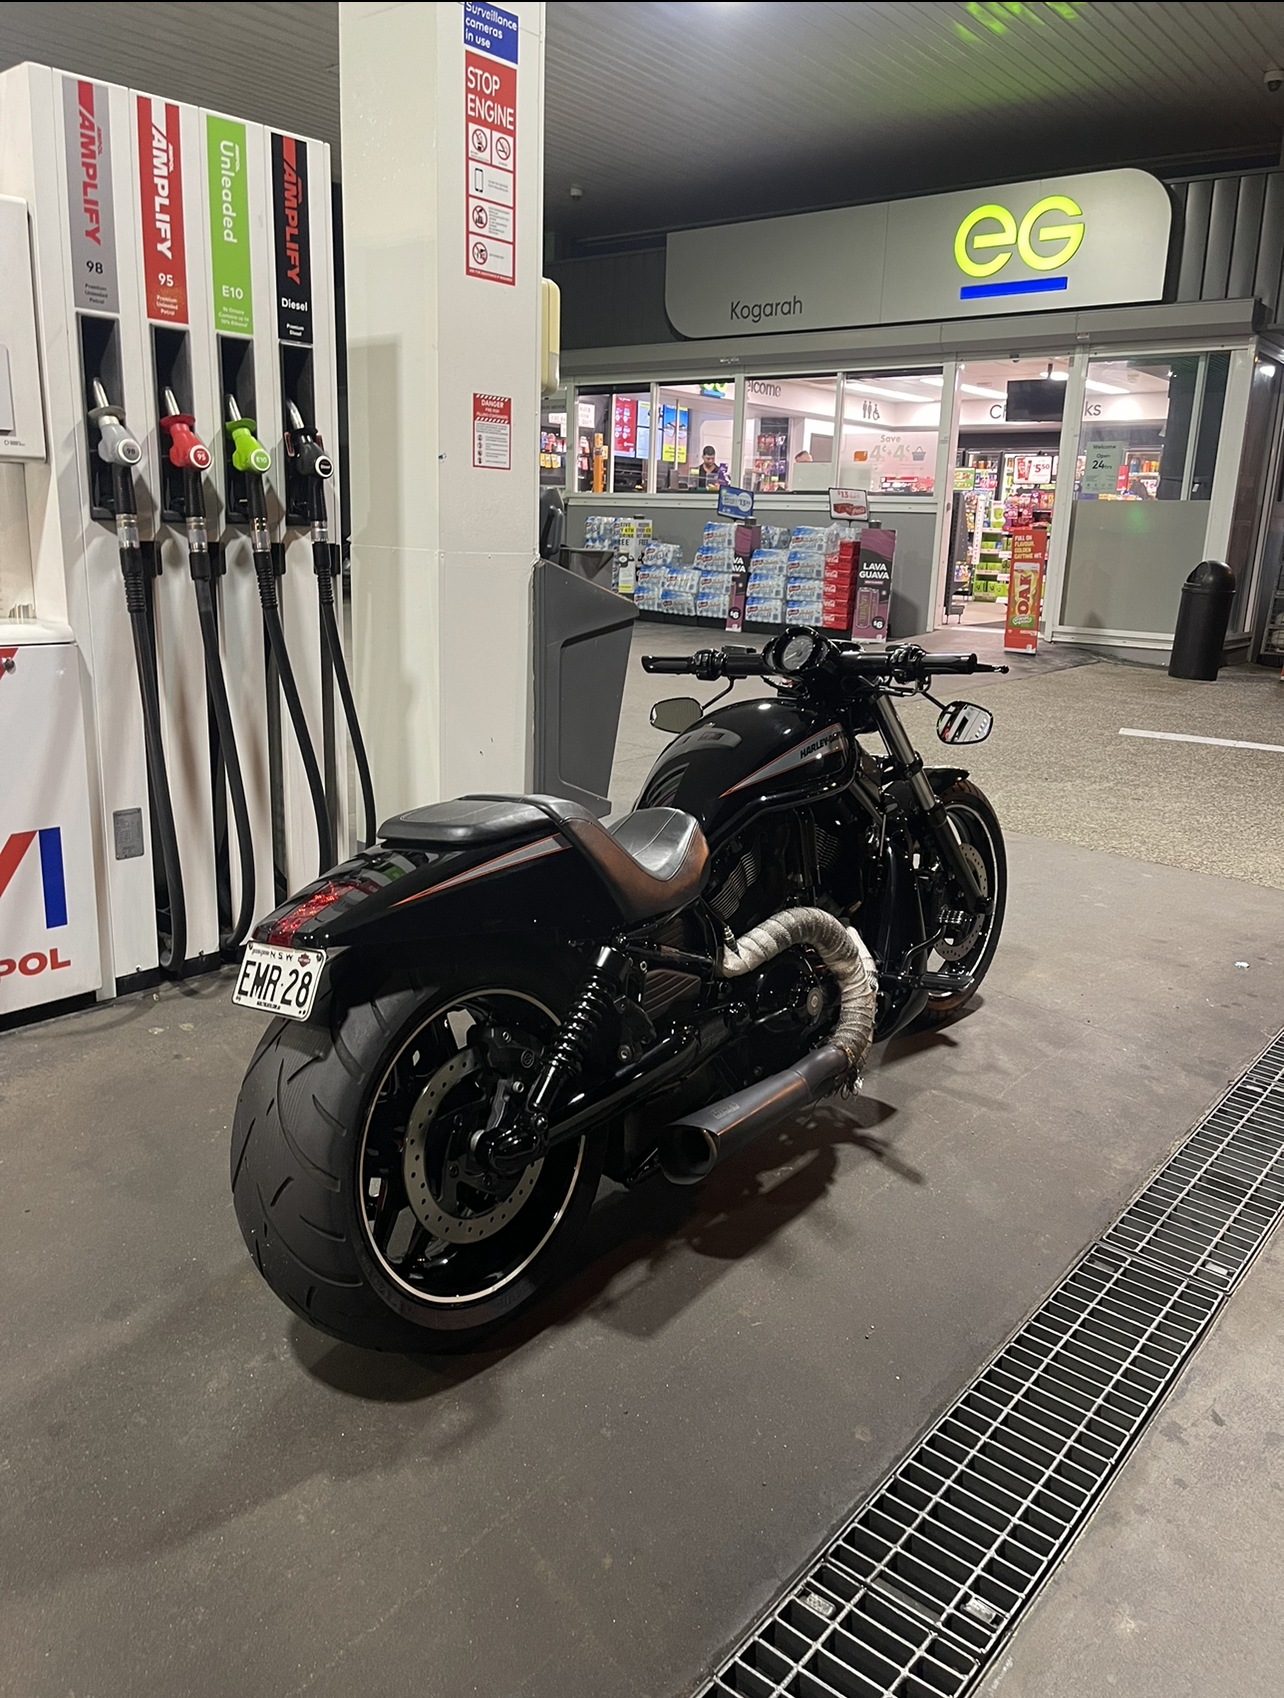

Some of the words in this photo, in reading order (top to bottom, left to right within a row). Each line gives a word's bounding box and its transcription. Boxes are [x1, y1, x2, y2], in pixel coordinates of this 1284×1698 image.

[466, 2, 517, 31] Surveillance
[466, 17, 503, 39] cameras
[465, 28, 474, 42] in
[475, 36, 491, 49] use
[467, 66, 500, 97] STOP
[467, 93, 514, 130] ENGINE
[79, 109, 101, 246] AMPLIFY
[151, 125, 172, 260] AMPLIFY
[220, 140, 238, 243] Unleaded
[283, 161, 300, 284] AMPLIFY
[86, 261, 103, 274] 98
[158, 273, 174, 287] 95
[157, 295, 177, 303] Premium
[222, 285, 244, 300] E10
[156, 301, 178, 310] Unleaded
[160, 308, 175, 316] Petrol
[281, 297, 308, 312] Diesel
[731, 295, 803, 323] Kogarah
[481, 399, 505, 408] DANGER
[880, 434, 902, 443] Save
[733, 557, 744, 565] VA
[863, 562, 887, 571] LAVA
[859, 570, 889, 579] GUAVA
[1017, 574, 1032, 615] OAK
[730, 610, 739, 619] $6
[873, 620, 883, 629] $6
